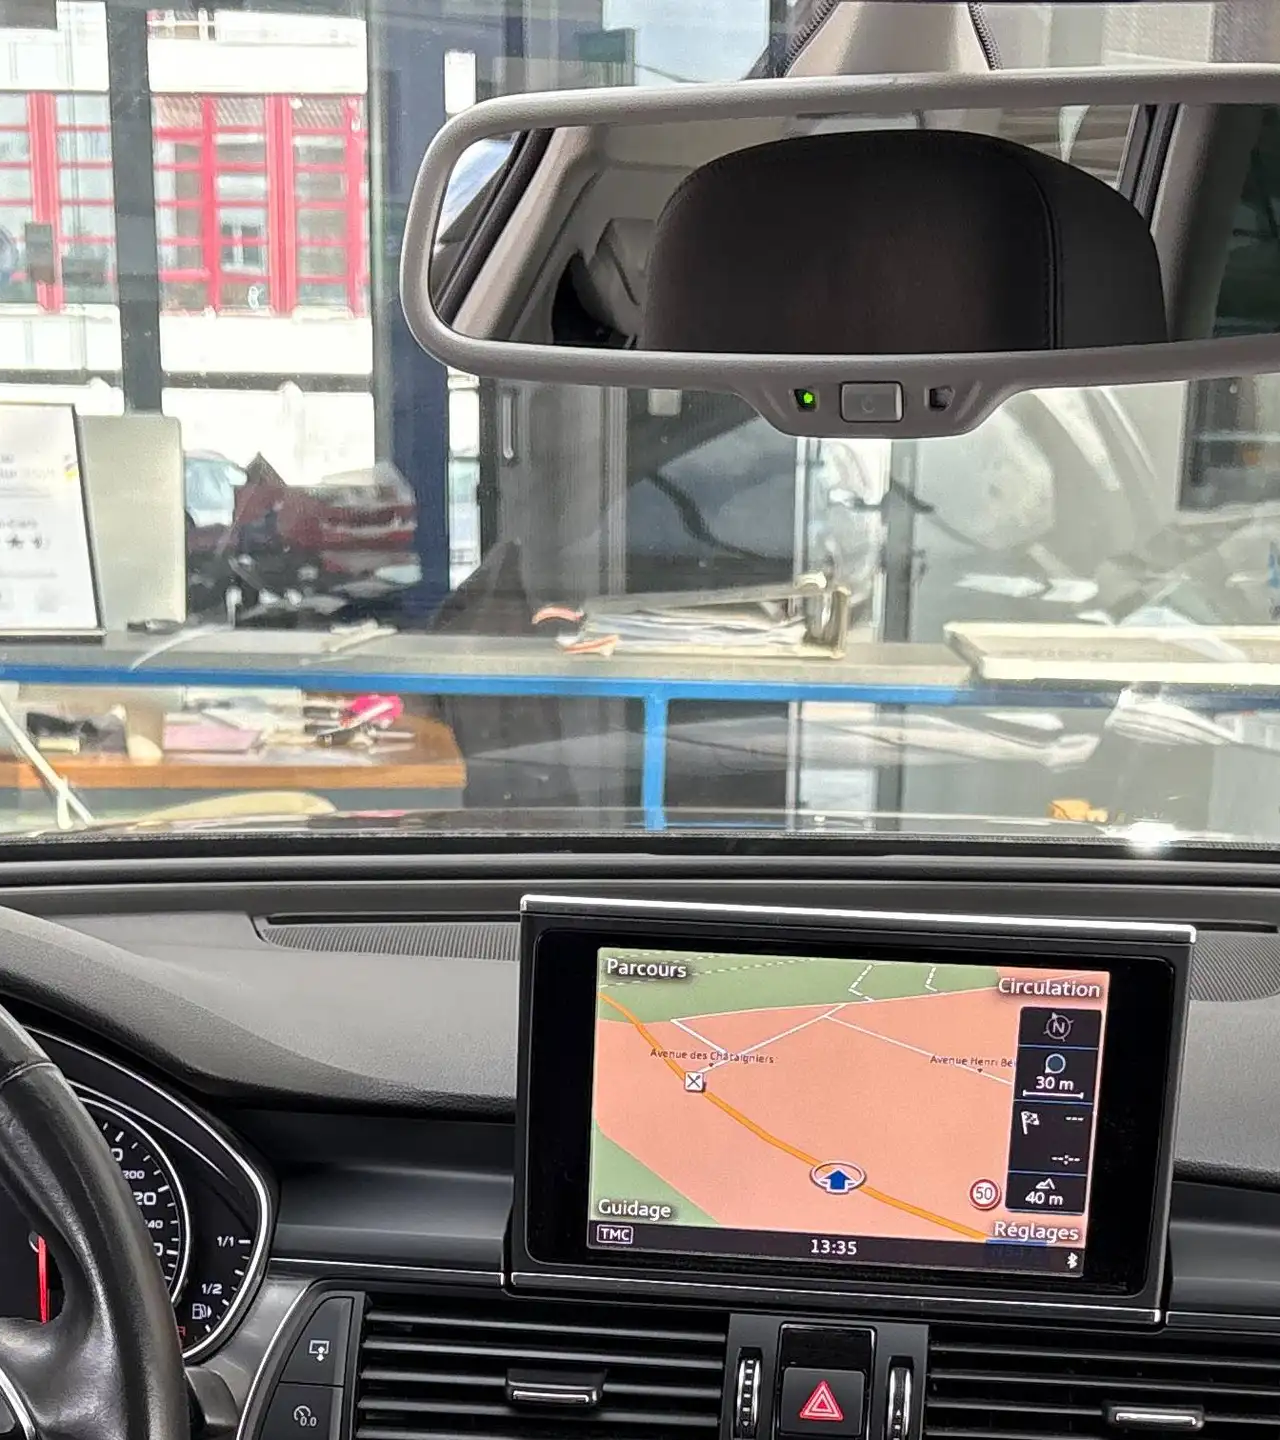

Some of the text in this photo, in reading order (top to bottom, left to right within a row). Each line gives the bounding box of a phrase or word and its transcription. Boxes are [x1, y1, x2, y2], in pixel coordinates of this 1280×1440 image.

[606, 958, 687, 979] Parcours
[998, 977, 1100, 998] Circulation
[649, 1049, 687, 1060] Avenue
[690, 1050, 707, 1061] des
[929, 1054, 968, 1066] Avenue
[1035, 1075, 1075, 1091] 30 m
[975, 1186, 994, 1201] 50
[1024, 1190, 1064, 1206] 40 m
[597, 1198, 672, 1222] Guidage
[600, 1226, 631, 1241] TMC
[993, 1220, 1080, 1244] Réglages
[216, 1235, 235, 1248] 1/1
[810, 1238, 858, 1256] 13:35
[201, 1283, 223, 1295] 1/2
